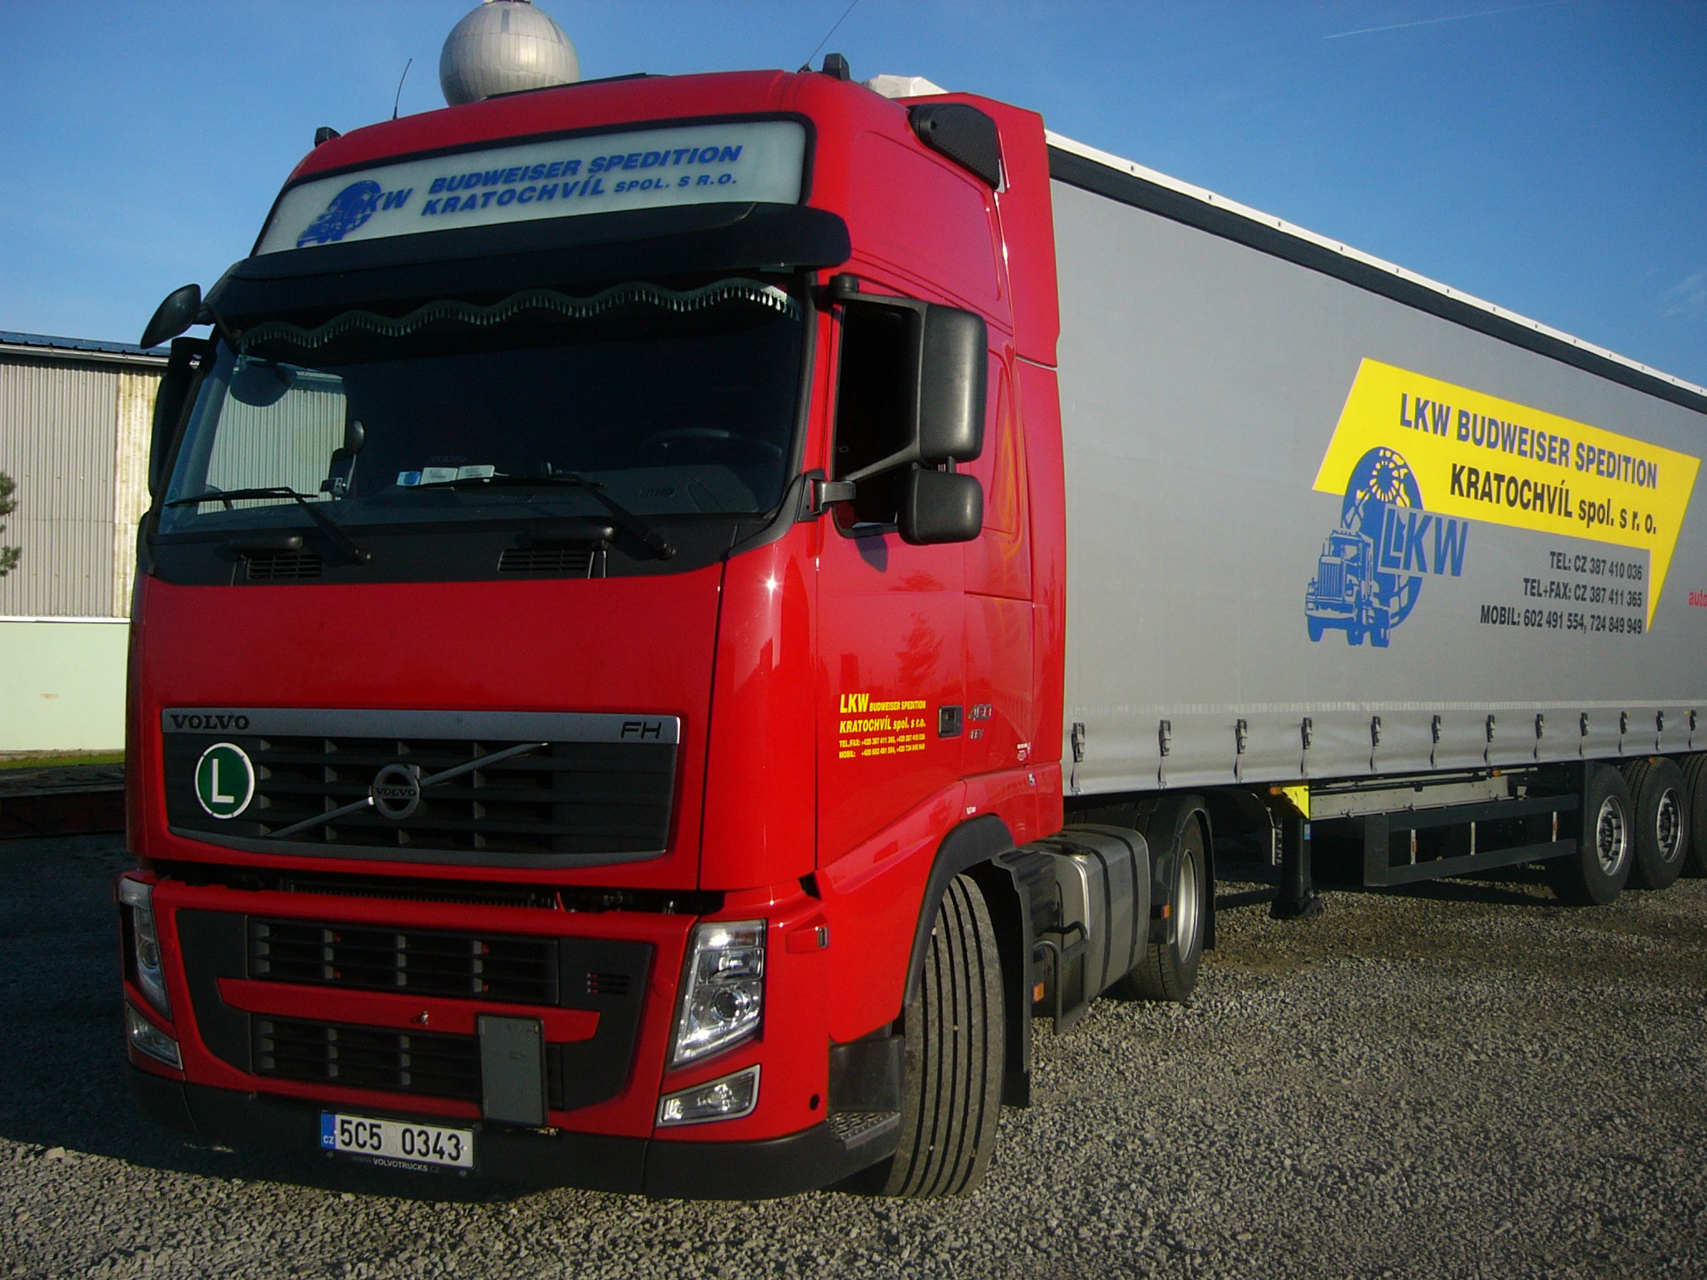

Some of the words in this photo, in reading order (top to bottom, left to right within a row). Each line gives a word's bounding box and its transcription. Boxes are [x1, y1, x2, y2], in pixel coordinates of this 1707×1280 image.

[428, 160, 582, 194] BUDWEISER
[588, 145, 743, 174] SPEDITION
[421, 174, 605, 216] KRATOCHVÍL
[614, 179, 669, 194] SPOL.
[678, 176, 691, 188] S
[697, 174, 738, 187] R.O.
[1400, 392, 1452, 437] LKW
[1457, 409, 1571, 468] BUDWEISER
[1575, 441, 1658, 489] SPEDITION
[1450, 463, 1573, 518] KRATOCHVÍL
[1578, 498, 1614, 528] spol.
[1619, 508, 1627, 529] s
[1632, 511, 1640, 531] r.
[1645, 513, 1656, 534] o.
[1380, 508, 1469, 577] LKW
[1550, 551, 1571, 571] TEL:
[1574, 555, 1587, 573] CZ
[1589, 557, 1606, 575] 387
[1608, 561, 1625, 578] 410
[1627, 563, 1642, 580] 036
[1523, 577, 1571, 600] TEL+FAX:
[1574, 583, 1587, 601] CZ
[1589, 586, 1606, 604] 387
[1608, 588, 1624, 606] 411
[1627, 590, 1642, 608] 365
[1480, 604, 1520, 626] MOBIL:
[1524, 608, 1543, 629] 602
[1546, 610, 1563, 629] 491
[1567, 612, 1587, 634] 554,
[1590, 614, 1606, 632] 724
[1608, 616, 1625, 633] 849
[1627, 617, 1642, 634] 949
[840, 693, 869, 713] LKW
[170, 715, 250, 730] VOLVO
[621, 721, 662, 739] FH
[839, 714, 891, 733] KRATOCHVÍL
[893, 716, 909, 732] spol.
[212, 758, 235, 803] L
[376, 787, 417, 797] VOLVO
[322, 1135, 334, 1145] CZ
[340, 1119, 382, 1151] 5C5
[402, 1128, 461, 1161] 0343
